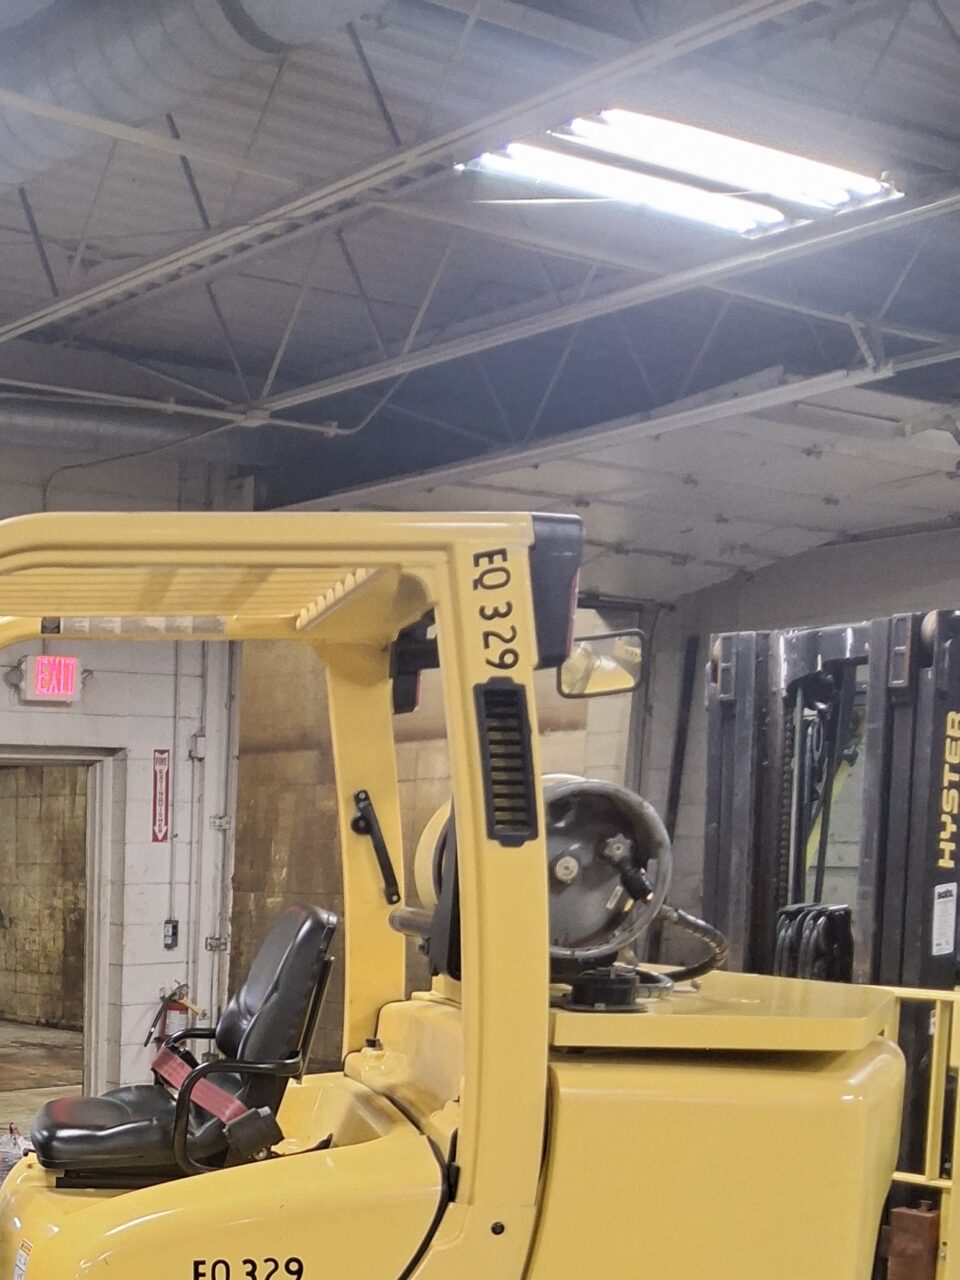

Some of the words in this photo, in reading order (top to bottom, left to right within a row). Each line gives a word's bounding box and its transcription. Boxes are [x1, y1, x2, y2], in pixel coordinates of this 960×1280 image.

[472, 547, 511, 591] EQ
[478, 599, 520, 671] 329
[36, 656, 77, 696] EXIT
[937, 711, 960, 869] HYSTER
